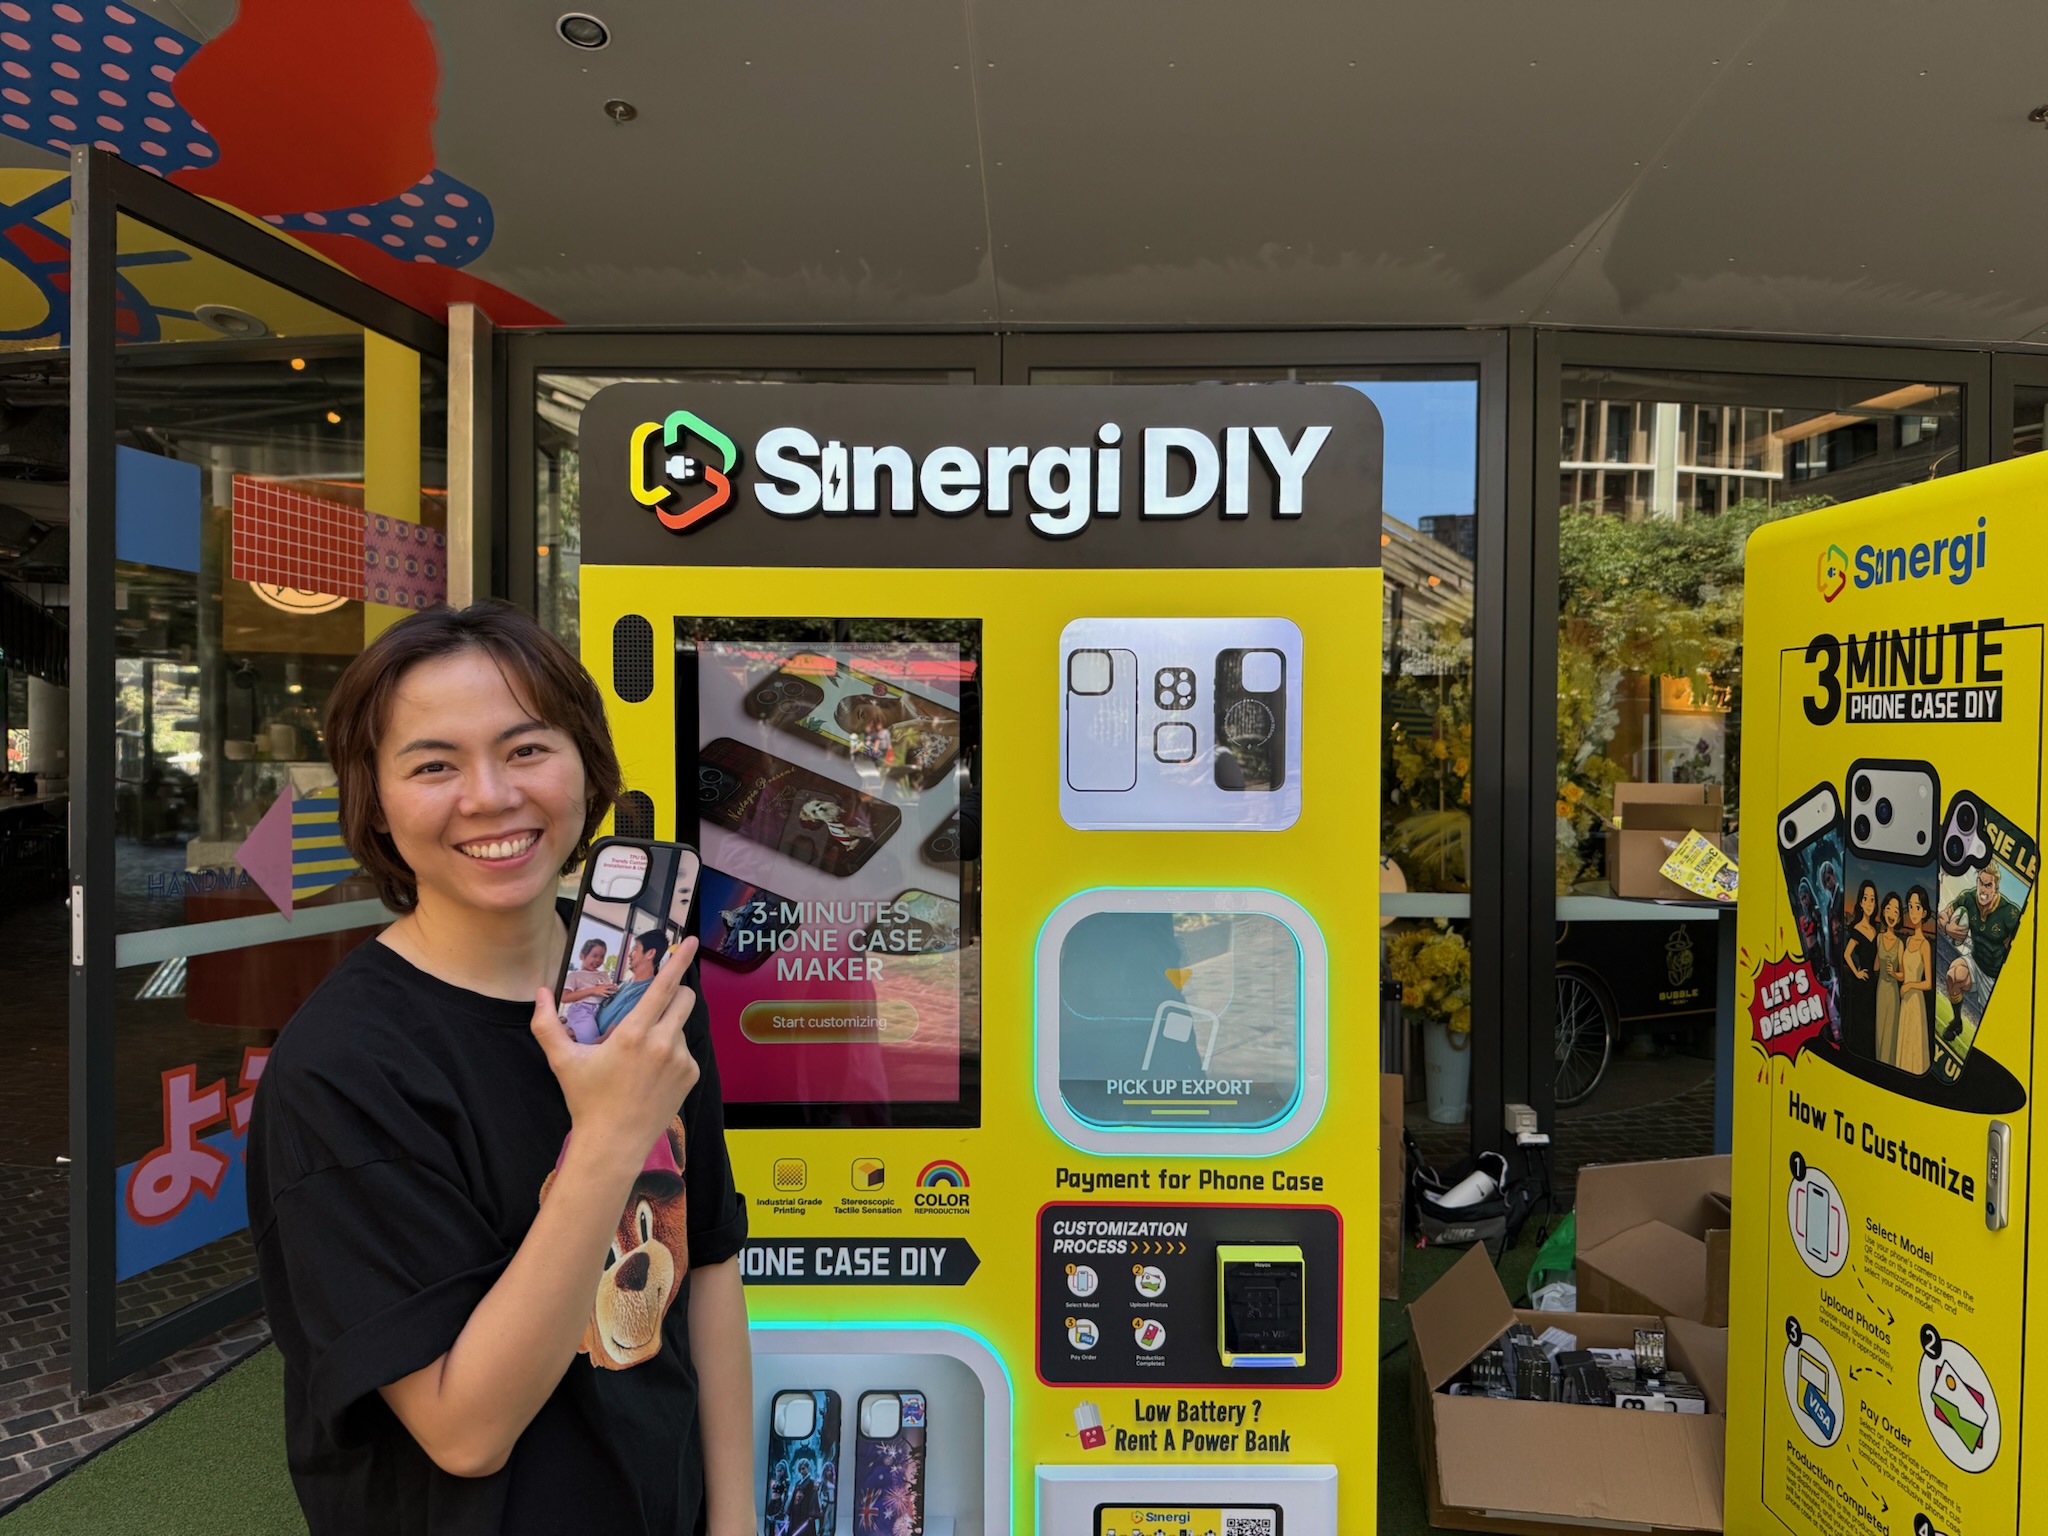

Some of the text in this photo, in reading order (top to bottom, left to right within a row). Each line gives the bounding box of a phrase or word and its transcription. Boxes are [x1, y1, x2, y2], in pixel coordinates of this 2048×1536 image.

[754, 421, 1333, 536] Sinergi DIY
[1854, 516, 1987, 589] Sinergi
[1803, 633, 1841, 726] 3
[1846, 617, 2005, 689] MINUTE
[1851, 689, 1998, 720] PHONE CASE DIY
[751, 901, 911, 925] 3-MINUTES
[738, 928, 923, 953] PHONE CASE
[777, 957, 884, 982] MAKER
[1659, 988, 1699, 1001] BUBBLE
[1760, 968, 1810, 1011] LET'S
[772, 1015, 888, 1031] Start customizing
[1759, 995, 1825, 1041] DESIGN
[1106, 1079, 1253, 1096] PICK UP EXPORT
[1789, 1089, 1827, 1132] How
[1834, 1109, 1855, 1145] To
[1862, 1122, 1975, 1202] Customize
[1056, 1167, 1324, 1193] Payment for Phone Case
[1794, 1156, 1801, 1177] 1
[756, 1197, 823, 1206] Industrial Grade
[773, 1206, 806, 1216] Printing
[833, 1206, 903, 1215] Tactile Sensation
[840, 1197, 895, 1207] Stereoscopic
[914, 1193, 970, 1207] COLOR
[1052, 1220, 1188, 1238] CUSTOMIZATION
[1865, 1216, 1934, 1265] Select Model
[1052, 1239, 1128, 1255] PROCESS
[815, 1247, 890, 1277] CASE
[900, 1247, 947, 1277] DIY
[1068, 1265, 1073, 1274] 1
[1135, 1266, 1141, 1274] 2
[1864, 1233, 1974, 1303] Use your phone's camera to scan the
[1863, 1254, 1957, 1316] the customization program, and
[1864, 1244, 1873, 1255] QR
[1873, 1250, 1888, 1264] code
[1888, 1259, 1896, 1269] on
[1896, 1263, 1907, 1276] the
[1933, 1285, 1957, 1305] screen,
[1957, 1299, 1975, 1314] enter
[1864, 1265, 1935, 1314] select your phone model.
[1068, 1319, 1074, 1327] 3
[1135, 1319, 1141, 1327] 4
[1818, 1315, 1829, 1328] and
[1829, 1322, 1851, 1344] beautify
[1820, 1287, 1892, 1346] Upload Photos
[1789, 1320, 1798, 1342] 3
[1838, 1319, 1851, 1332] your
[1851, 1324, 1873, 1348] favorite
[1873, 1341, 1891, 1360] photo
[1924, 1329, 1936, 1356] 2
[1134, 1399, 1262, 1427] Low Battery ?
[1809, 1391, 1831, 1431] VISA
[1860, 1399, 1912, 1449] Pay Order
[1114, 1428, 1292, 1453] Rent A Power Bank
[1859, 1416, 1949, 1492] Select an appropriate payment
[1786, 1439, 1890, 1536] Production Completed
[1889, 1462, 1900, 1475] the
[1900, 1471, 1920, 1492] device
[1921, 1487, 1932, 1501] will
[1932, 1495, 1948, 1513] start
[1898, 1458, 1909, 1471] the
[1909, 1466, 1925, 1484] order
[1925, 1481, 1955, 1509] payment
[1955, 1500, 1962, 1514] is
[1924, 1500, 1945, 1522] phone
